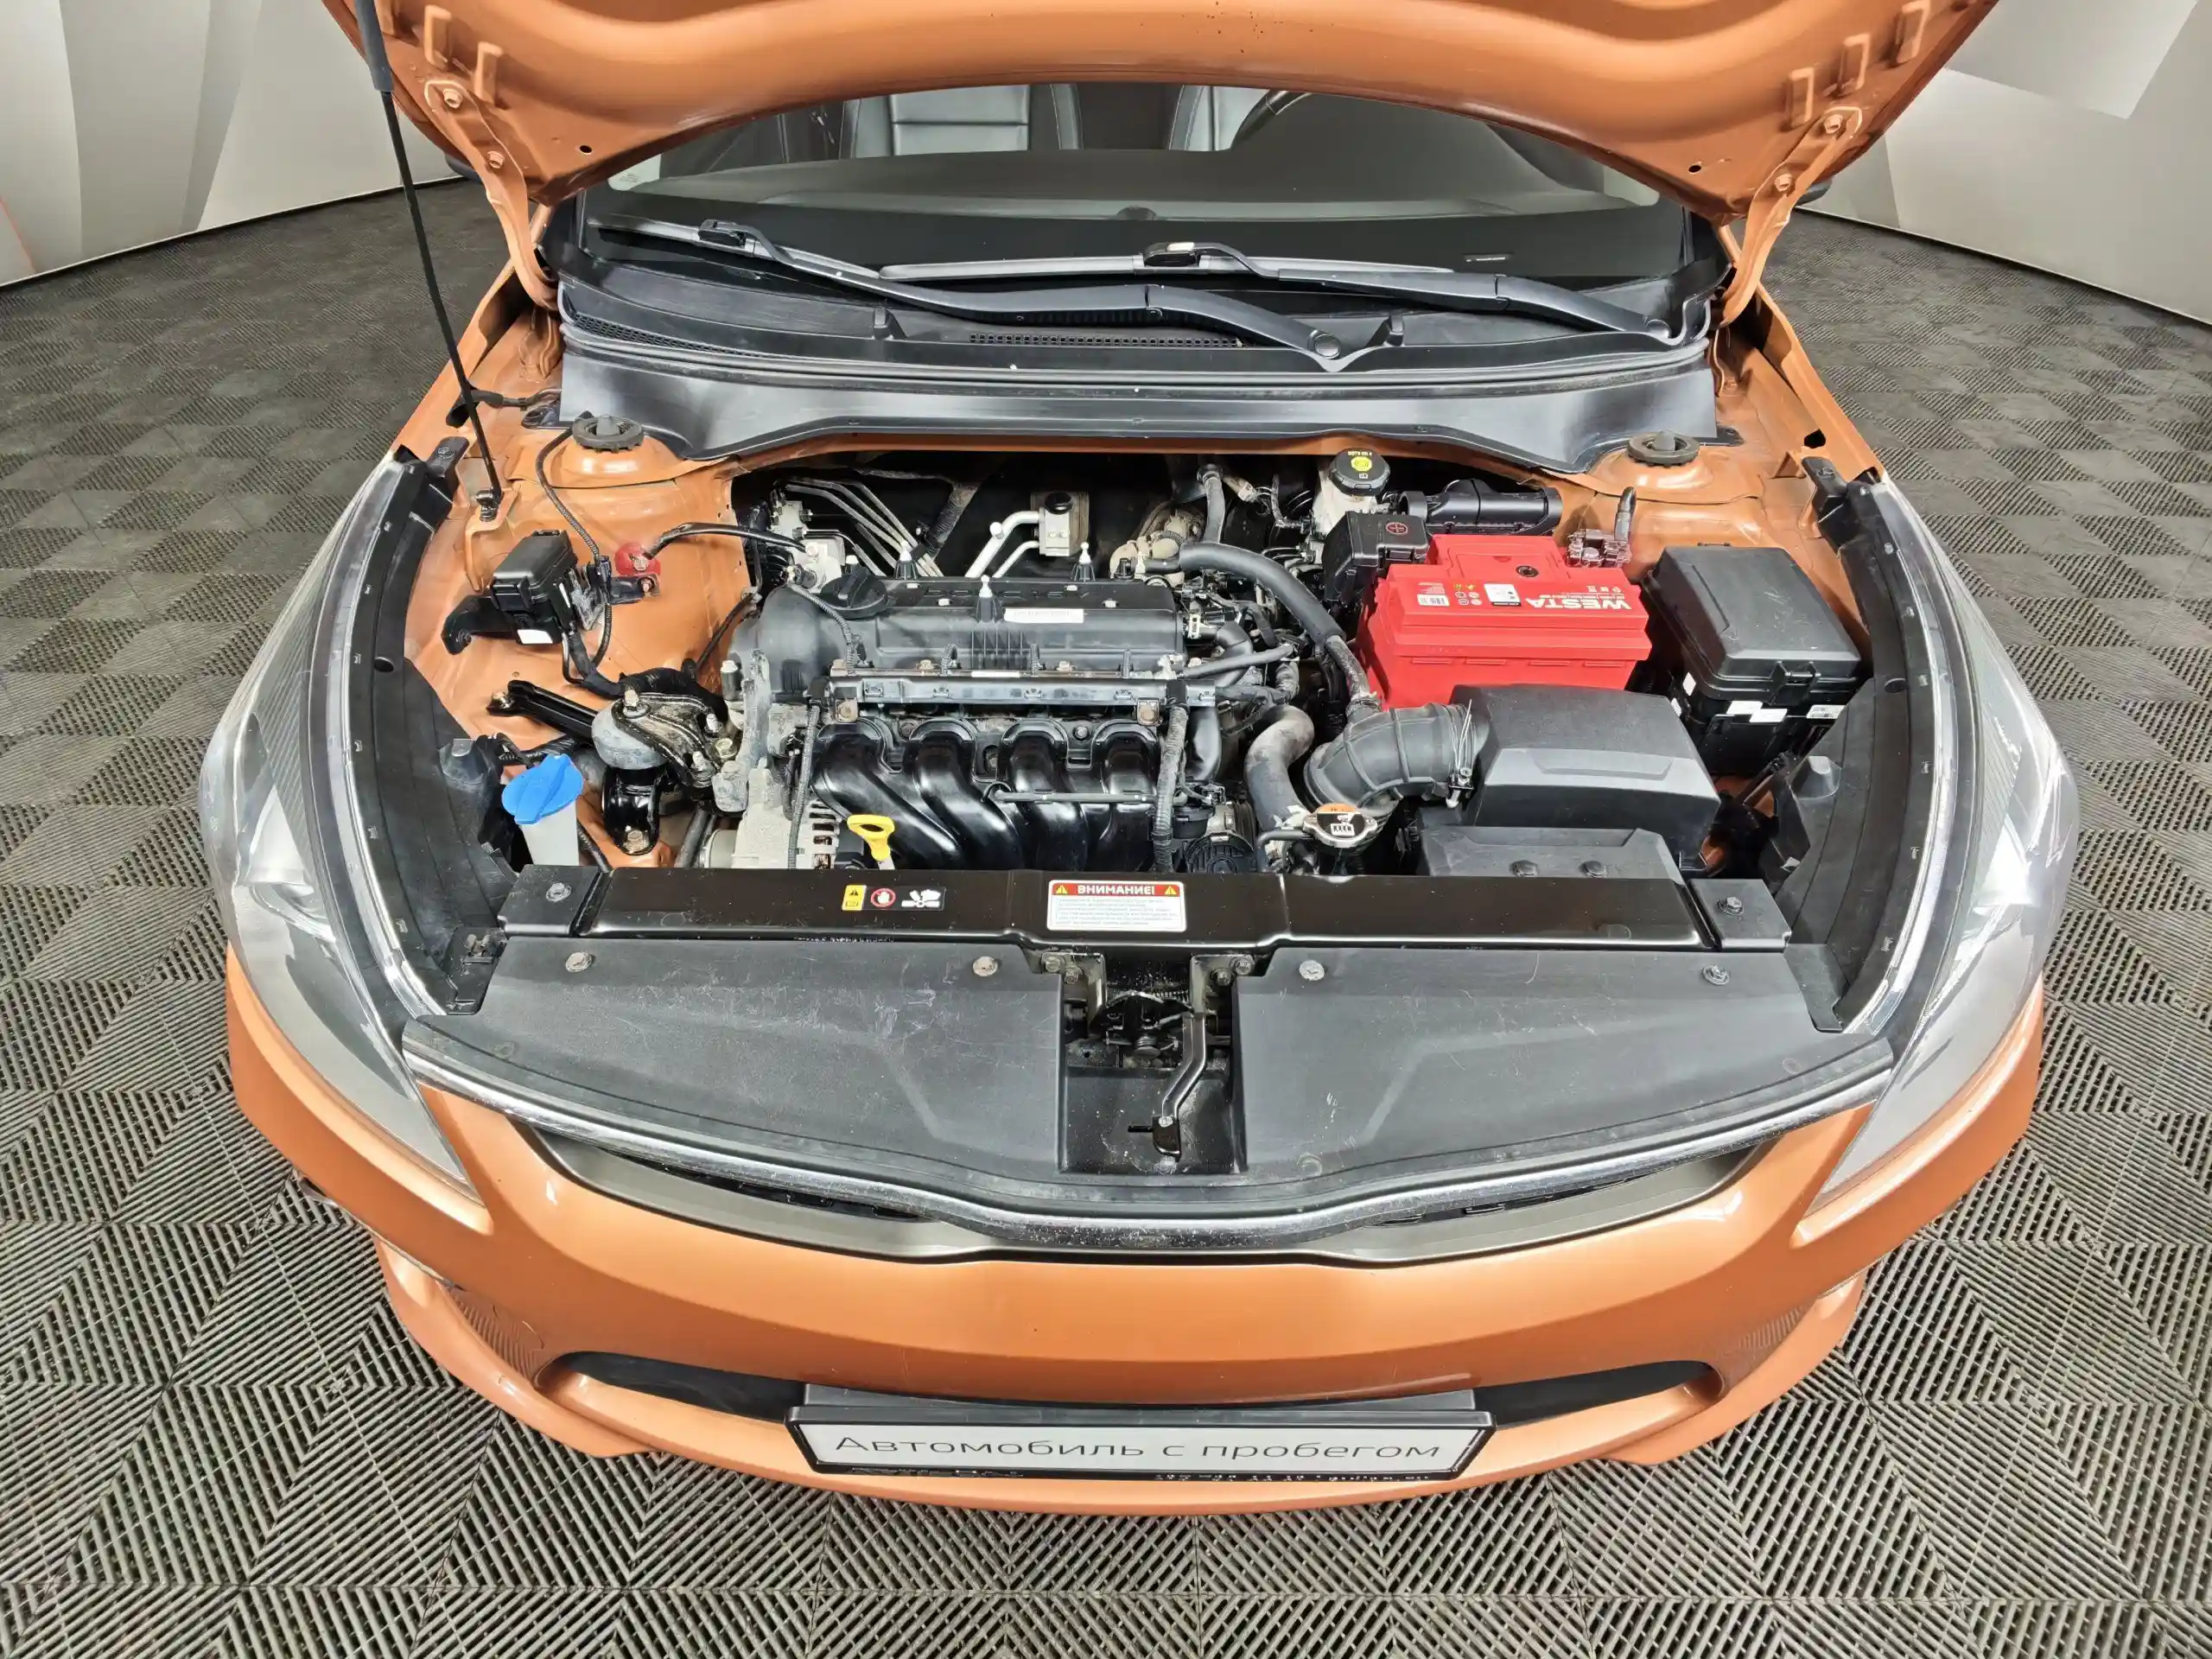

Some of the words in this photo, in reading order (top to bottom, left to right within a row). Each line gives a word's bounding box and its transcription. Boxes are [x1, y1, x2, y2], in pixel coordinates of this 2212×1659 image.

[1525, 597, 1632, 610] WESTA
[1077, 884, 1155, 895] ВНИМАНИЕ!
[836, 1436, 1145, 1457] Автомобиль
[1162, 1445, 1185, 1458] с
[1201, 1442, 1441, 1460] пробегом
